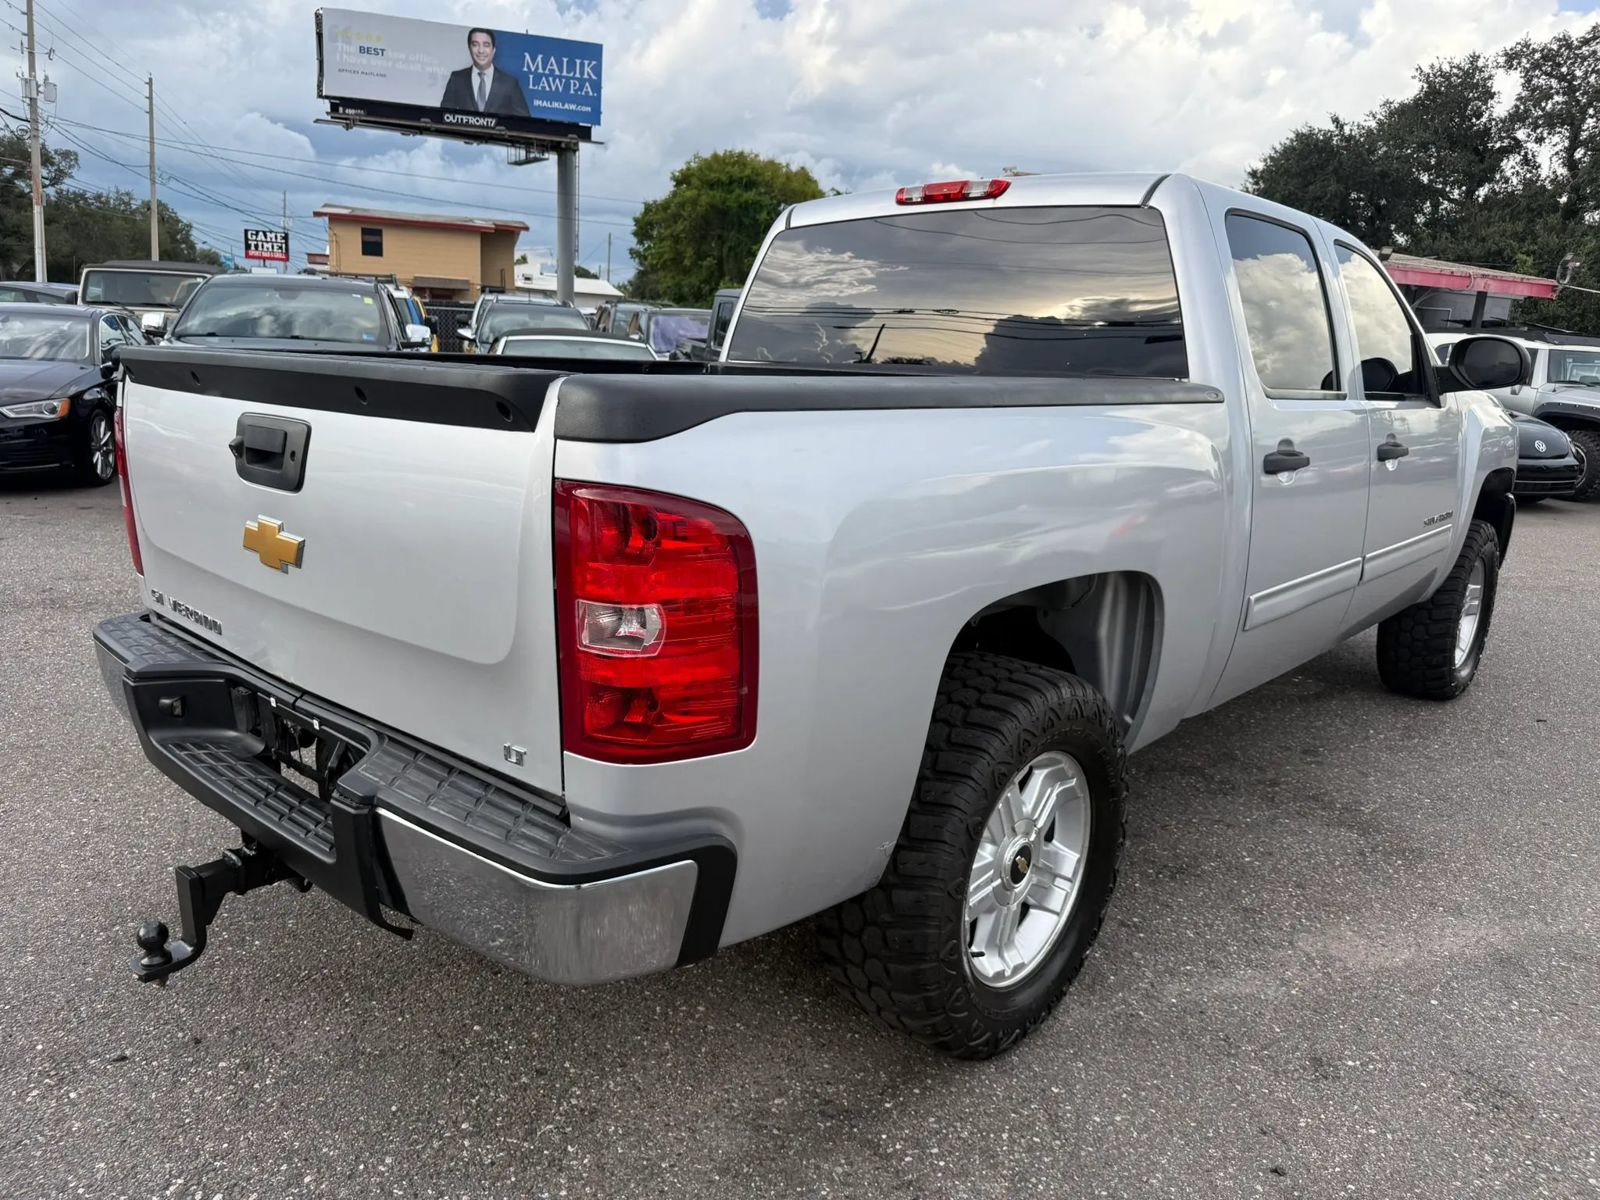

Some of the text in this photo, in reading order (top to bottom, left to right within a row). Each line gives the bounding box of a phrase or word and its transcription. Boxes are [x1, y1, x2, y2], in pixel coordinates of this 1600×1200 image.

[359, 45, 386, 57] BEST
[522, 52, 598, 80] MALIK
[528, 74, 597, 97] LAW P.A.
[248, 231, 285, 243] GAME
[248, 241, 286, 253] TIME!
